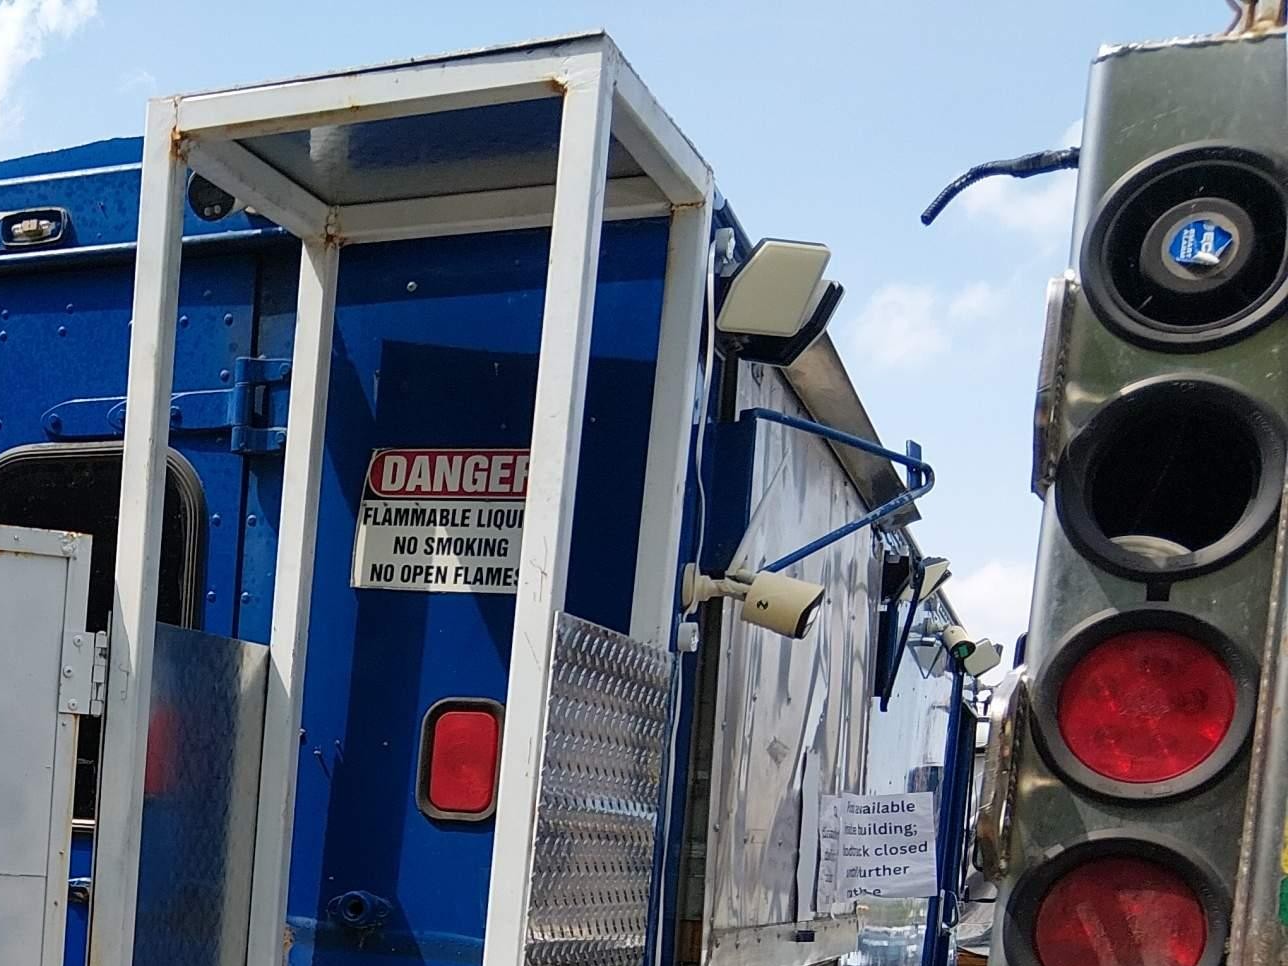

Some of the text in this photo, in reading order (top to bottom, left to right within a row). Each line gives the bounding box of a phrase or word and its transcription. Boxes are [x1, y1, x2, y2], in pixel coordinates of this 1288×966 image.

[363, 507, 525, 530] FLAMMABLE LIQUI
[393, 536, 509, 558] NO SMOKING
[370, 564, 394, 582] NO
[400, 565, 448, 584] OPEN
[874, 841, 928, 857] closed
